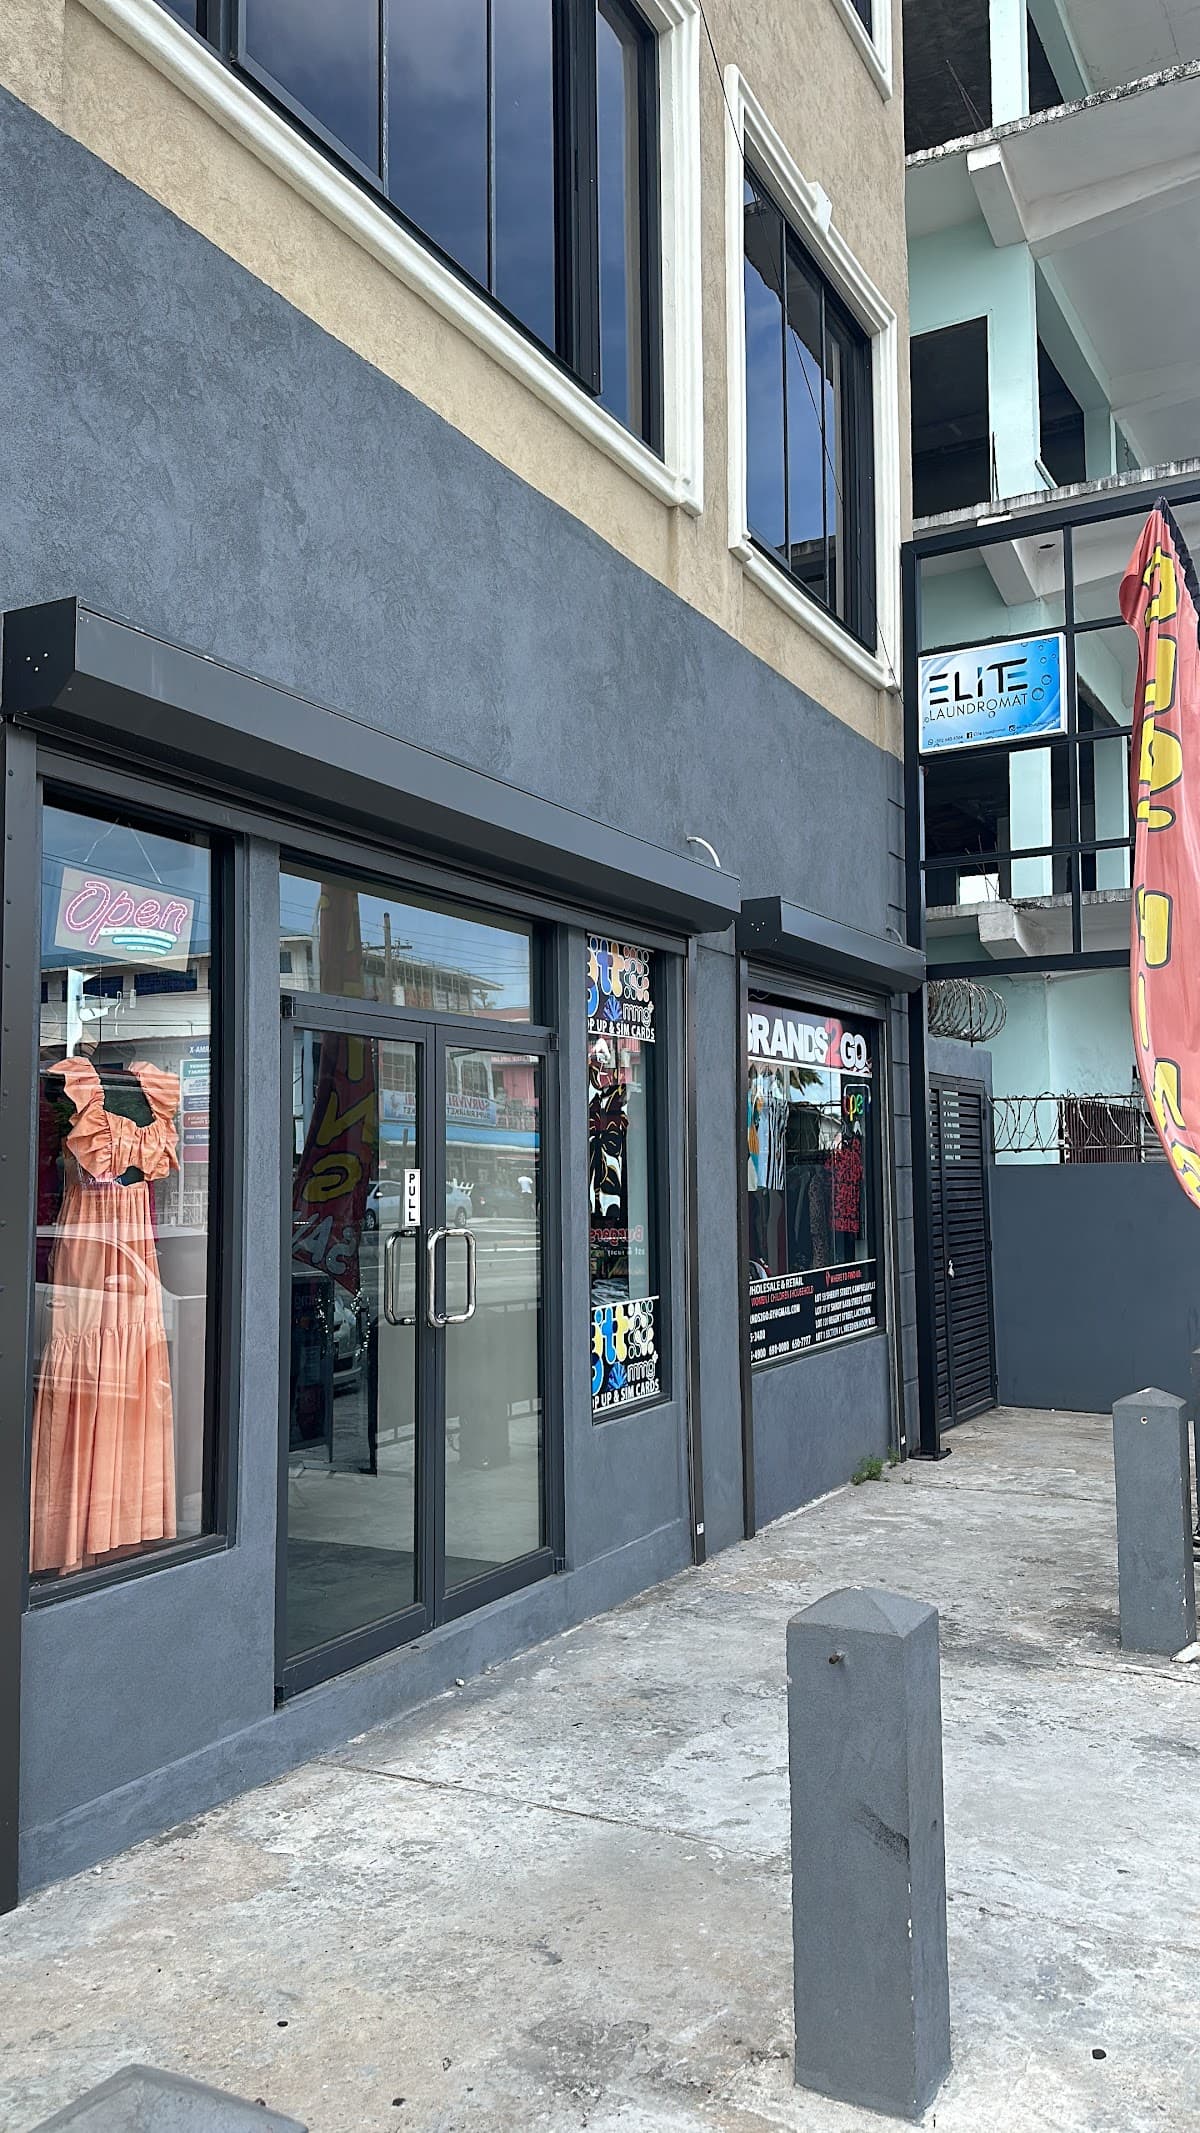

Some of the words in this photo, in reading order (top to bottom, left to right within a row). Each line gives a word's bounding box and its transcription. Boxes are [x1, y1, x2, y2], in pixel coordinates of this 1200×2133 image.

[929, 658, 1028, 705] ELITE
[929, 693, 1028, 721] LAUNDROMAT
[66, 880, 188, 945] Open
[596, 1020, 608, 1032] UP
[609, 1021, 615, 1033] &
[616, 1022, 630, 1036] SIM
[631, 1025, 655, 1040] CARDS
[408, 1173, 416, 1221] PULL
[781, 1279, 786, 1290] &
[786, 1276, 804, 1288] RETAIL
[601, 1391, 612, 1407] UP
[613, 1388, 620, 1403] &
[621, 1384, 634, 1400] SIM
[635, 1379, 660, 1398] CARDS
